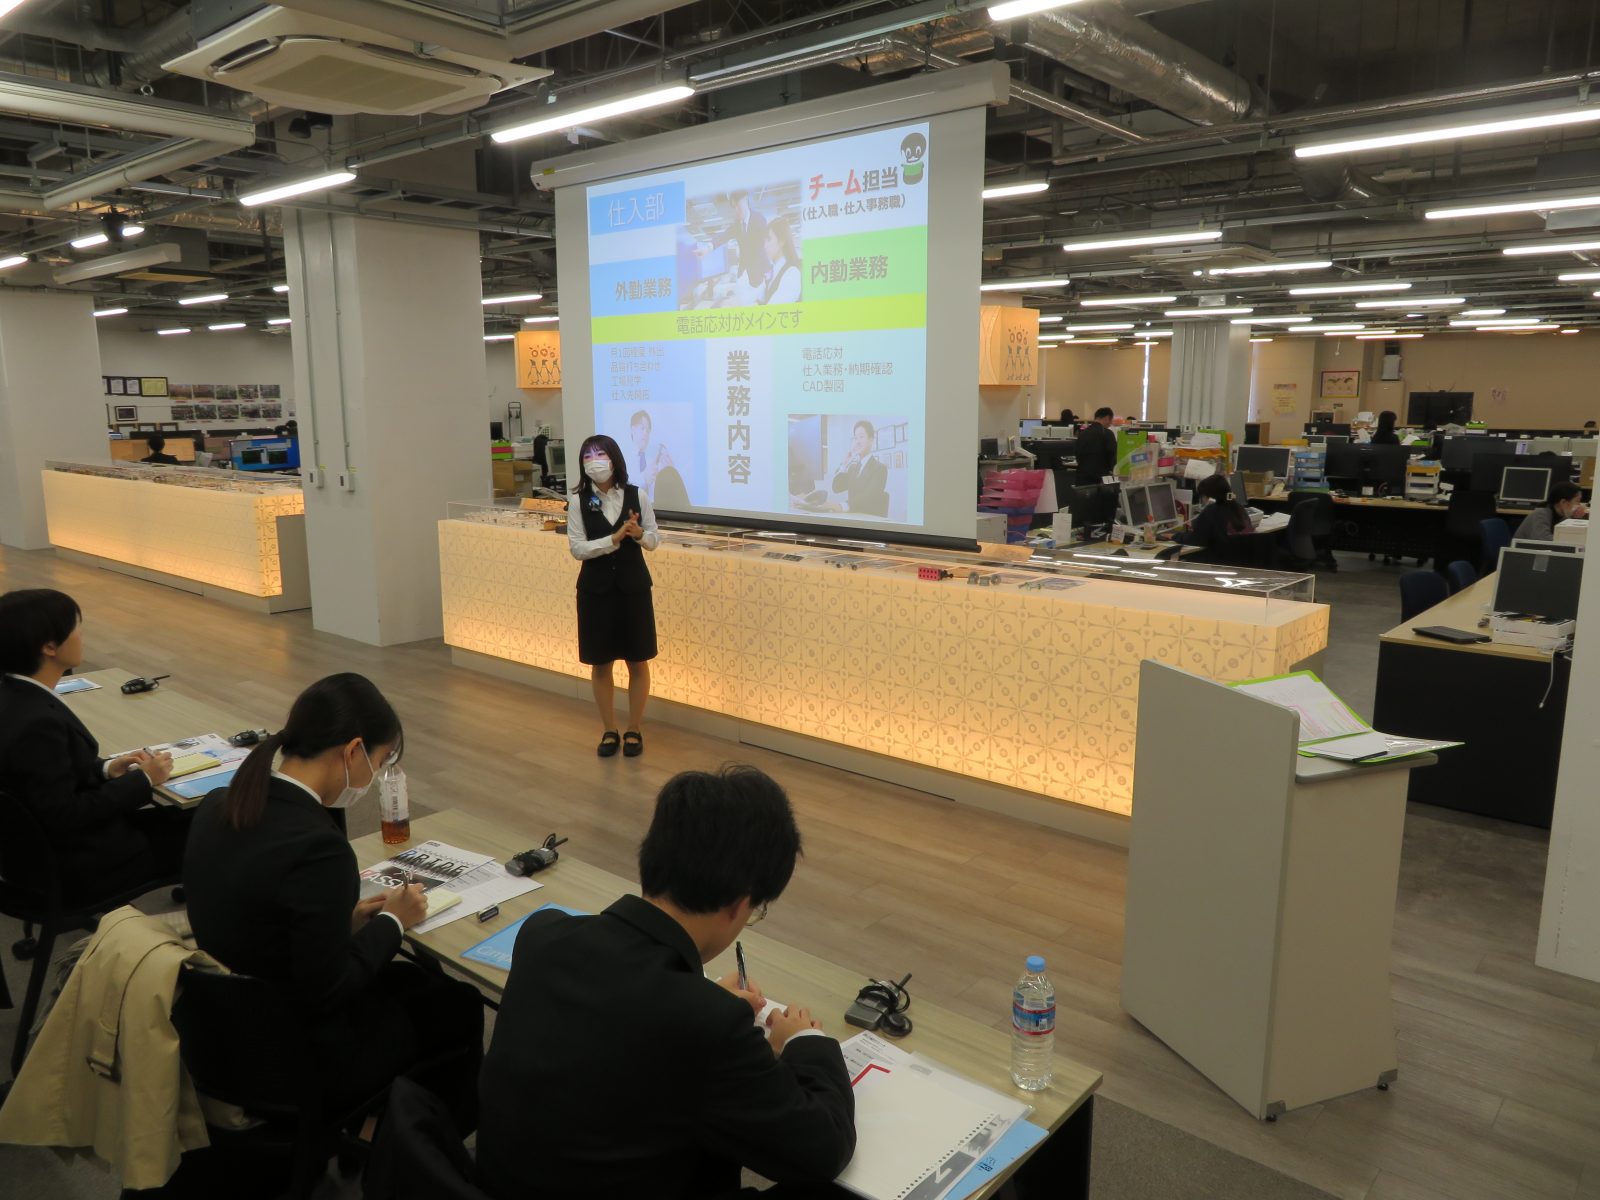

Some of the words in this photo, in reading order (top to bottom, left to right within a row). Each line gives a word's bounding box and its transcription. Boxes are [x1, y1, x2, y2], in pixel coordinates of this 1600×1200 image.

[809, 166, 898, 200] チーム担当
[608, 192, 664, 227] 仕入部
[811, 255, 888, 284] 内勤業務
[616, 277, 672, 302] 外勤業務
[676, 309, 803, 335] 電話応対がメインです
[802, 347, 843, 361] 電話応対
[802, 361, 894, 377] 仕入業務・納期確認
[802, 380, 845, 393] CAD製図
[726, 350, 751, 484] 業務内容
